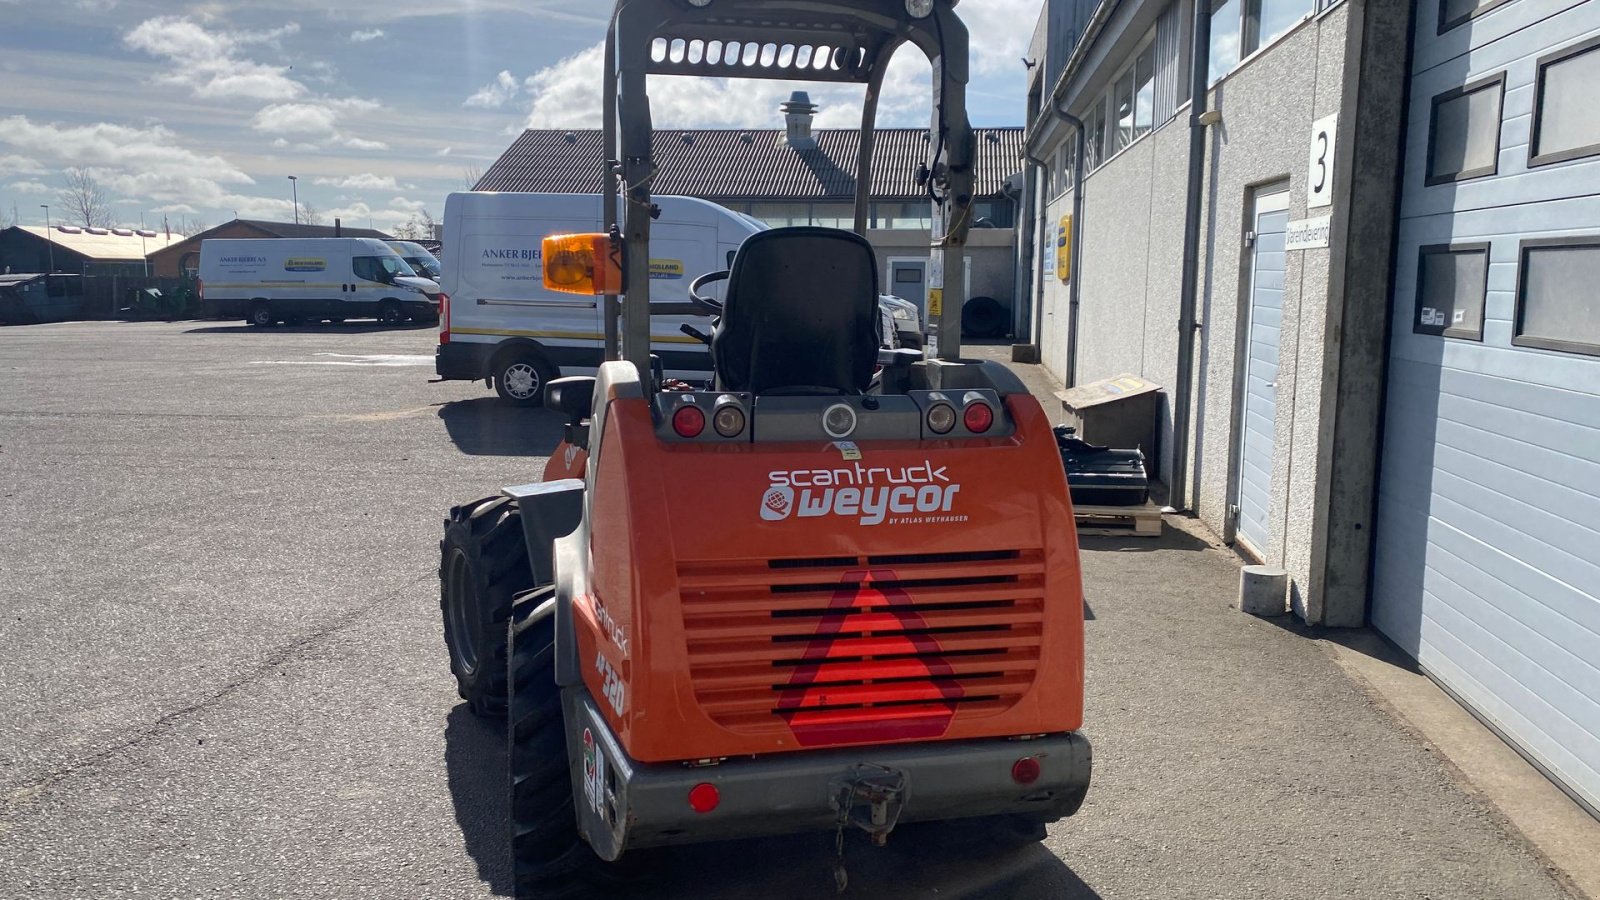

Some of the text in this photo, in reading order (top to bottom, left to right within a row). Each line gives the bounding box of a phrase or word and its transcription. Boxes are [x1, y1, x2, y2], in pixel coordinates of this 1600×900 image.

[1314, 131, 1328, 194] 3
[482, 249, 519, 259] ANKER
[768, 459, 950, 487] scantruck
[797, 484, 960, 526] weycor
[602, 661, 625, 718] 320
